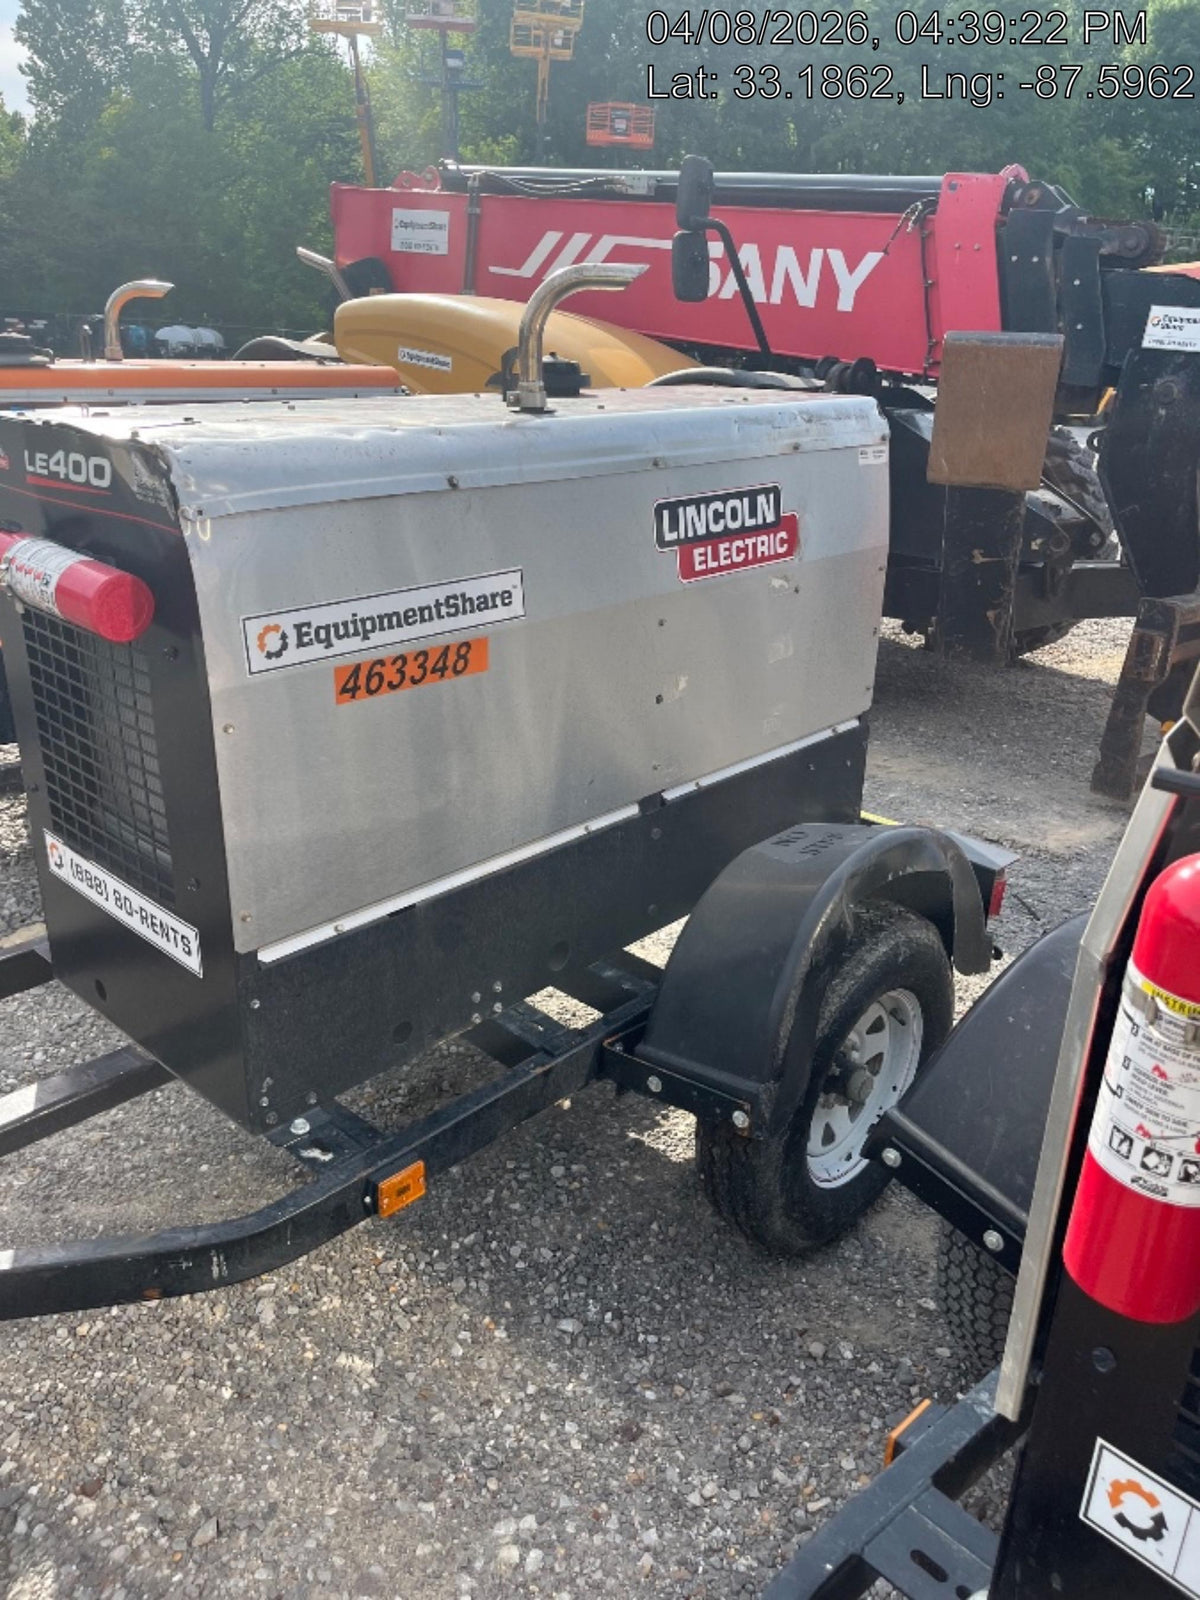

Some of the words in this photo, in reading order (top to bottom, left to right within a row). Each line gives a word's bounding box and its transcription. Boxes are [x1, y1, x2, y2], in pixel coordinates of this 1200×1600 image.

[24, 449, 112, 488] LE400
[662, 492, 776, 541] LINCOLN
[693, 531, 788, 571] ELECTRIC
[293, 588, 514, 649] EquipmentShare
[339, 641, 472, 699] 463348
[69, 857, 110, 902] (888)
[113, 888, 193, 957] 80-RENTS
